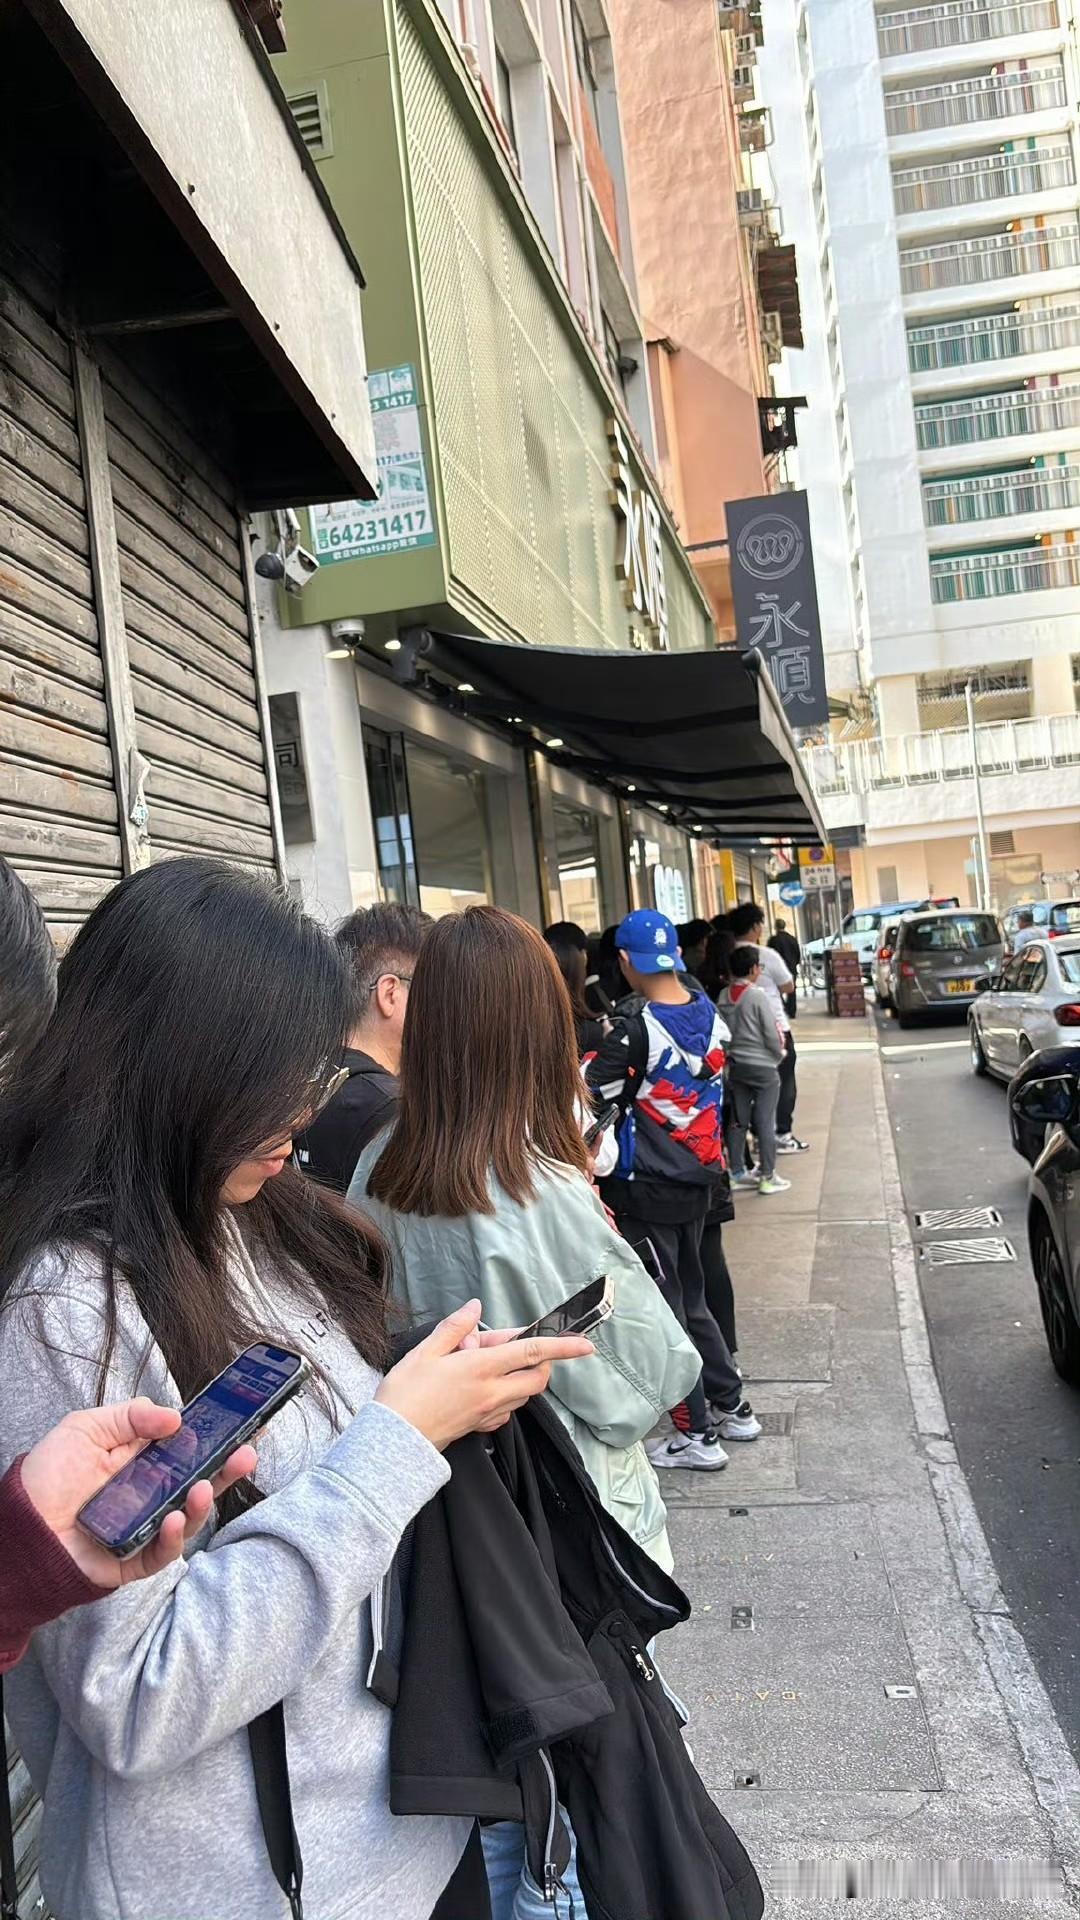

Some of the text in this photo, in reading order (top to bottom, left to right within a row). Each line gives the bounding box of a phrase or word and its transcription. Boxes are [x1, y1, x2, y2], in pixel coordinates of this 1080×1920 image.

[383, 394, 412, 408] 1417
[329, 510, 426, 546] 64231417
[749, 592, 816, 705] 永順
[804, 867, 815, 875] 24
